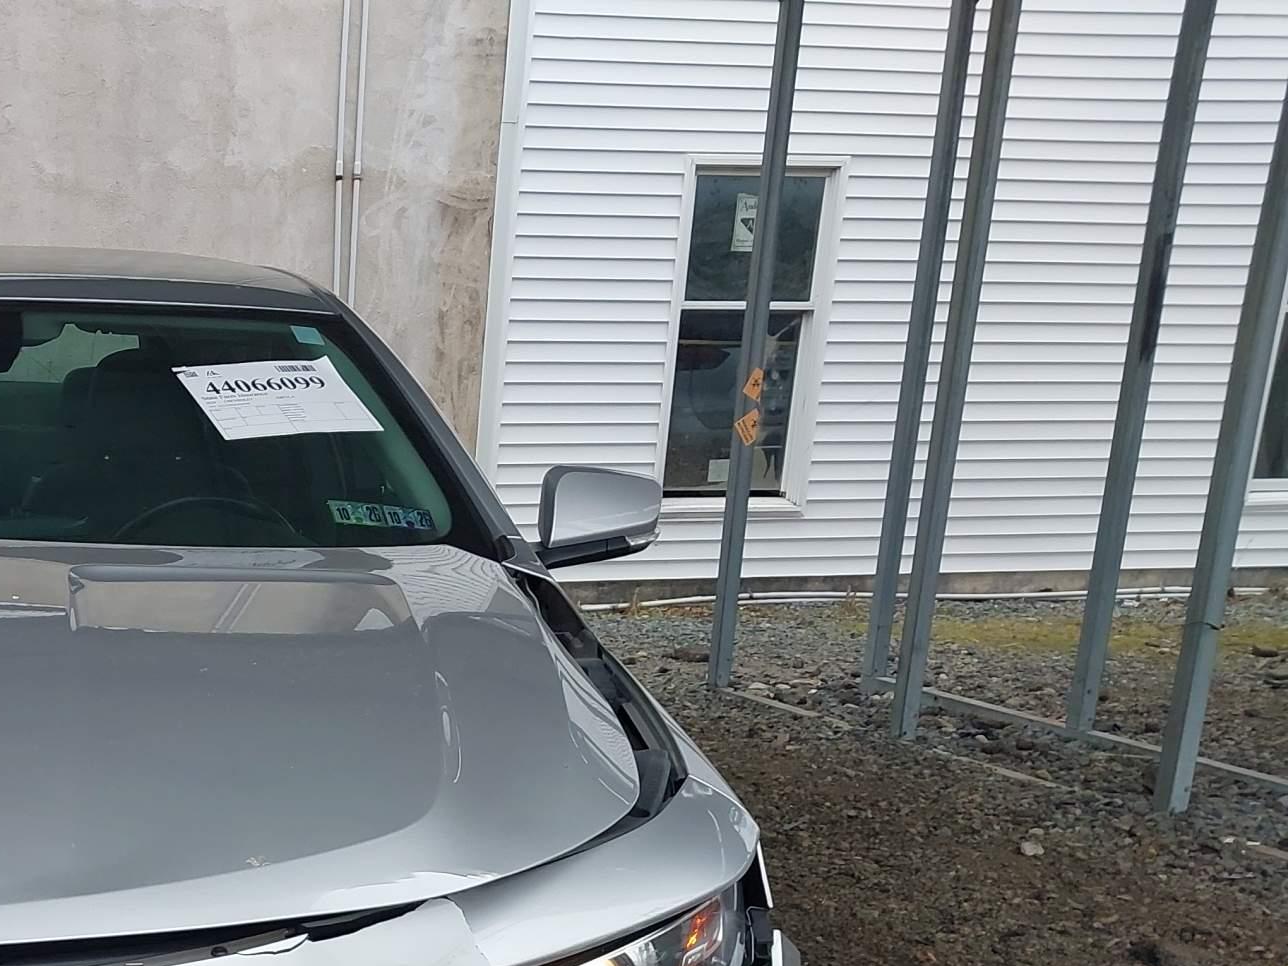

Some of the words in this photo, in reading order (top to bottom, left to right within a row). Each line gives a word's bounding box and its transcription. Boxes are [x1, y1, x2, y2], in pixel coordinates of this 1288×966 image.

[206, 376, 325, 395] 44066099
[336, 507, 351, 521] 10
[387, 511, 402, 524] 10
